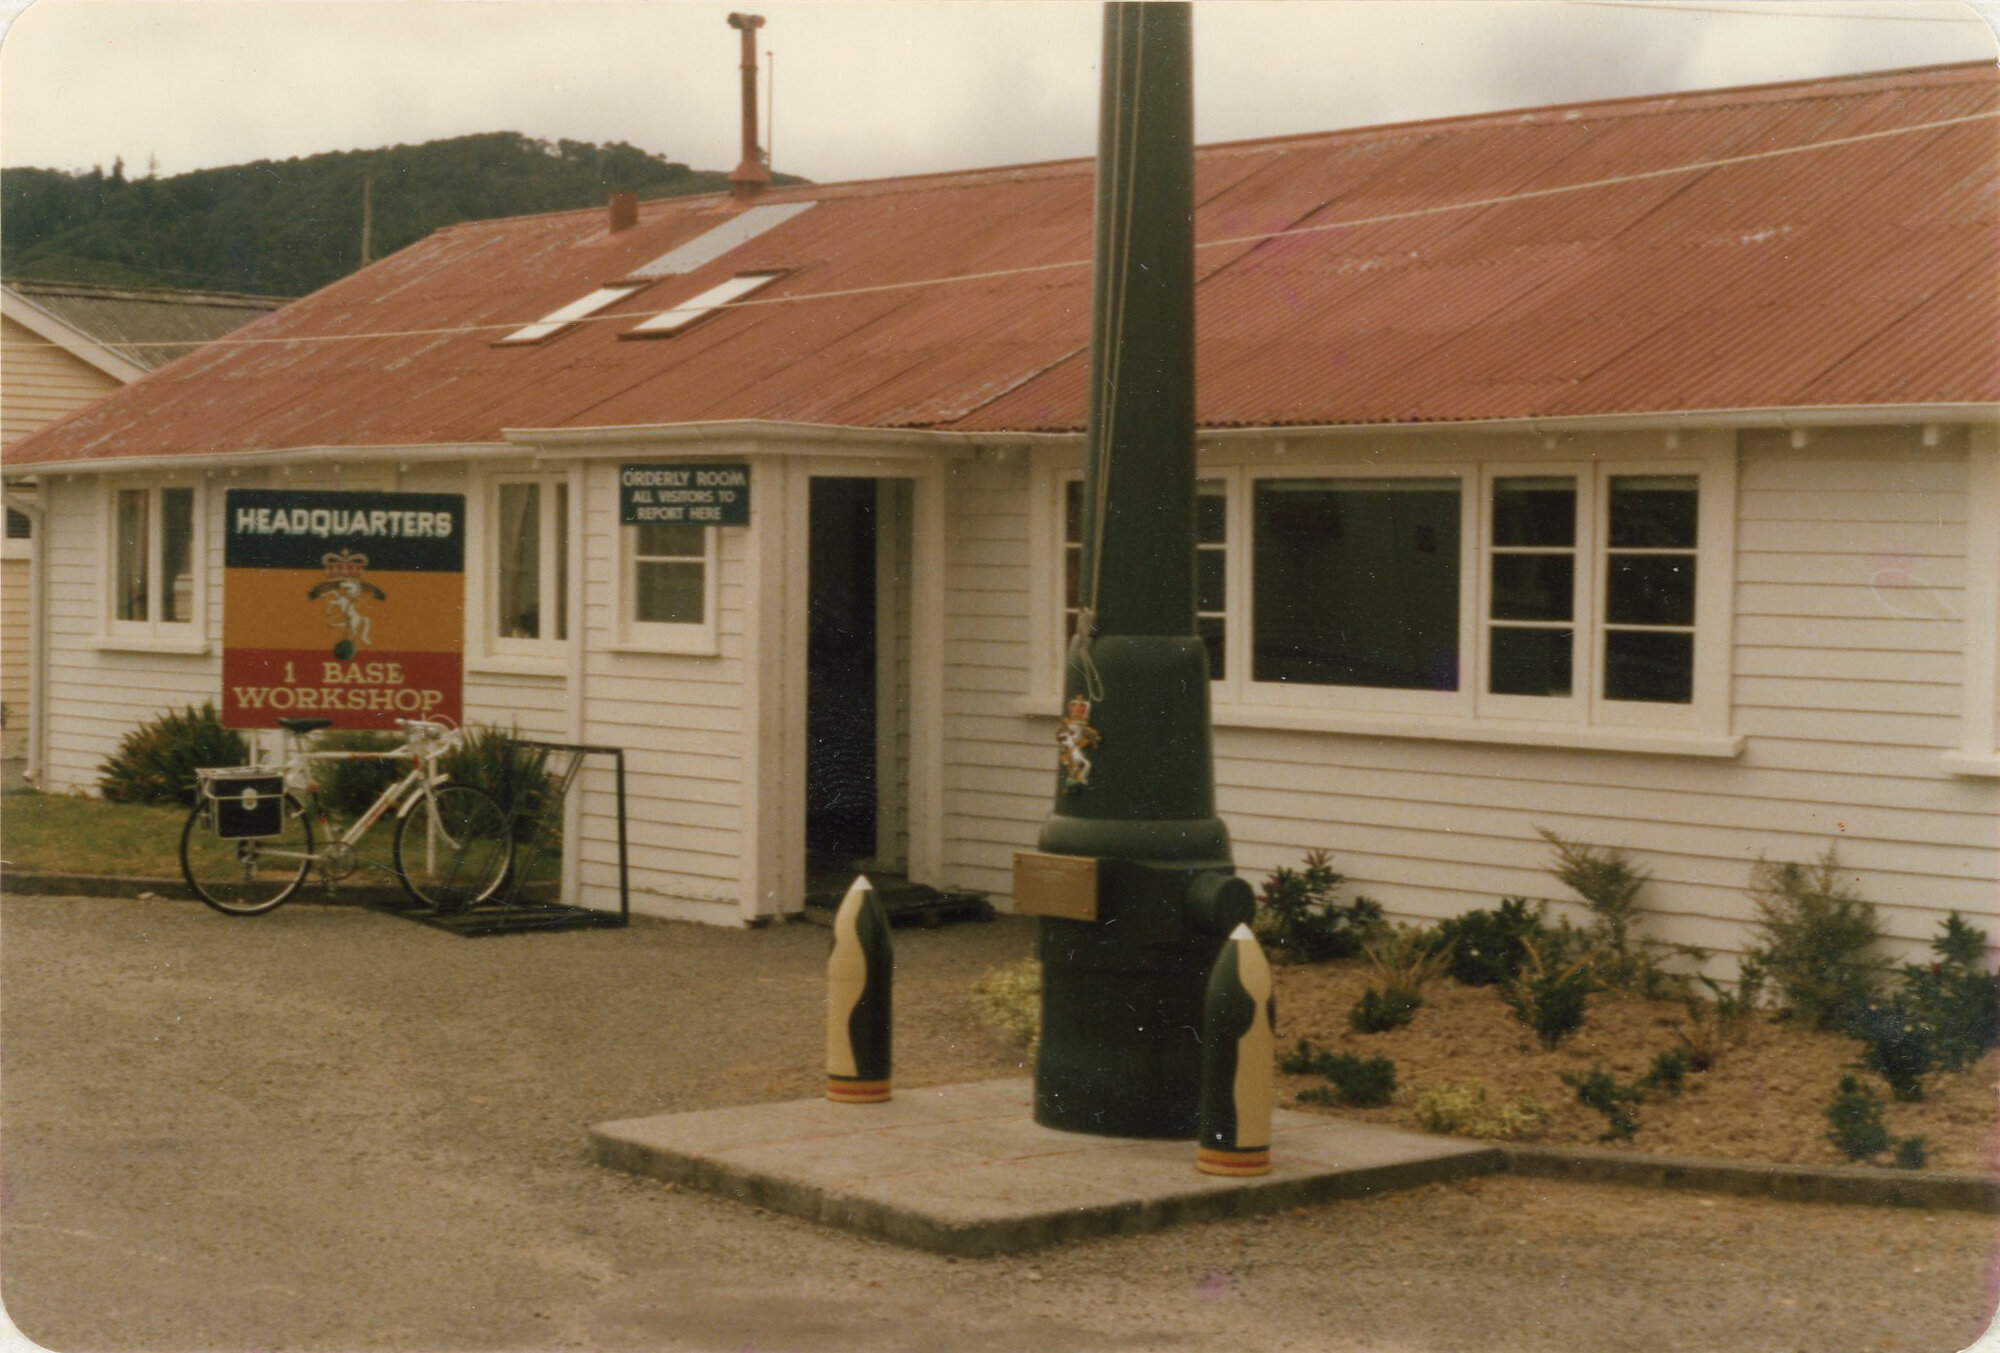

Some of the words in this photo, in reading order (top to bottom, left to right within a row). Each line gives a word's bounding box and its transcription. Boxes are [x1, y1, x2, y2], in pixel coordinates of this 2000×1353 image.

[623, 471, 689, 486] ORDERLY
[697, 471, 746, 486] ROOM
[632, 490, 652, 502] ALL
[658, 490, 714, 502] VISITORS
[718, 490, 735, 502] TO
[637, 506, 684, 520] REPORT
[690, 506, 721, 520] HERE
[237, 508, 452, 538] HEADQUARTERS
[284, 662, 296, 683] 1
[323, 662, 405, 684] BASE
[233, 687, 443, 711] WORKSHOP
